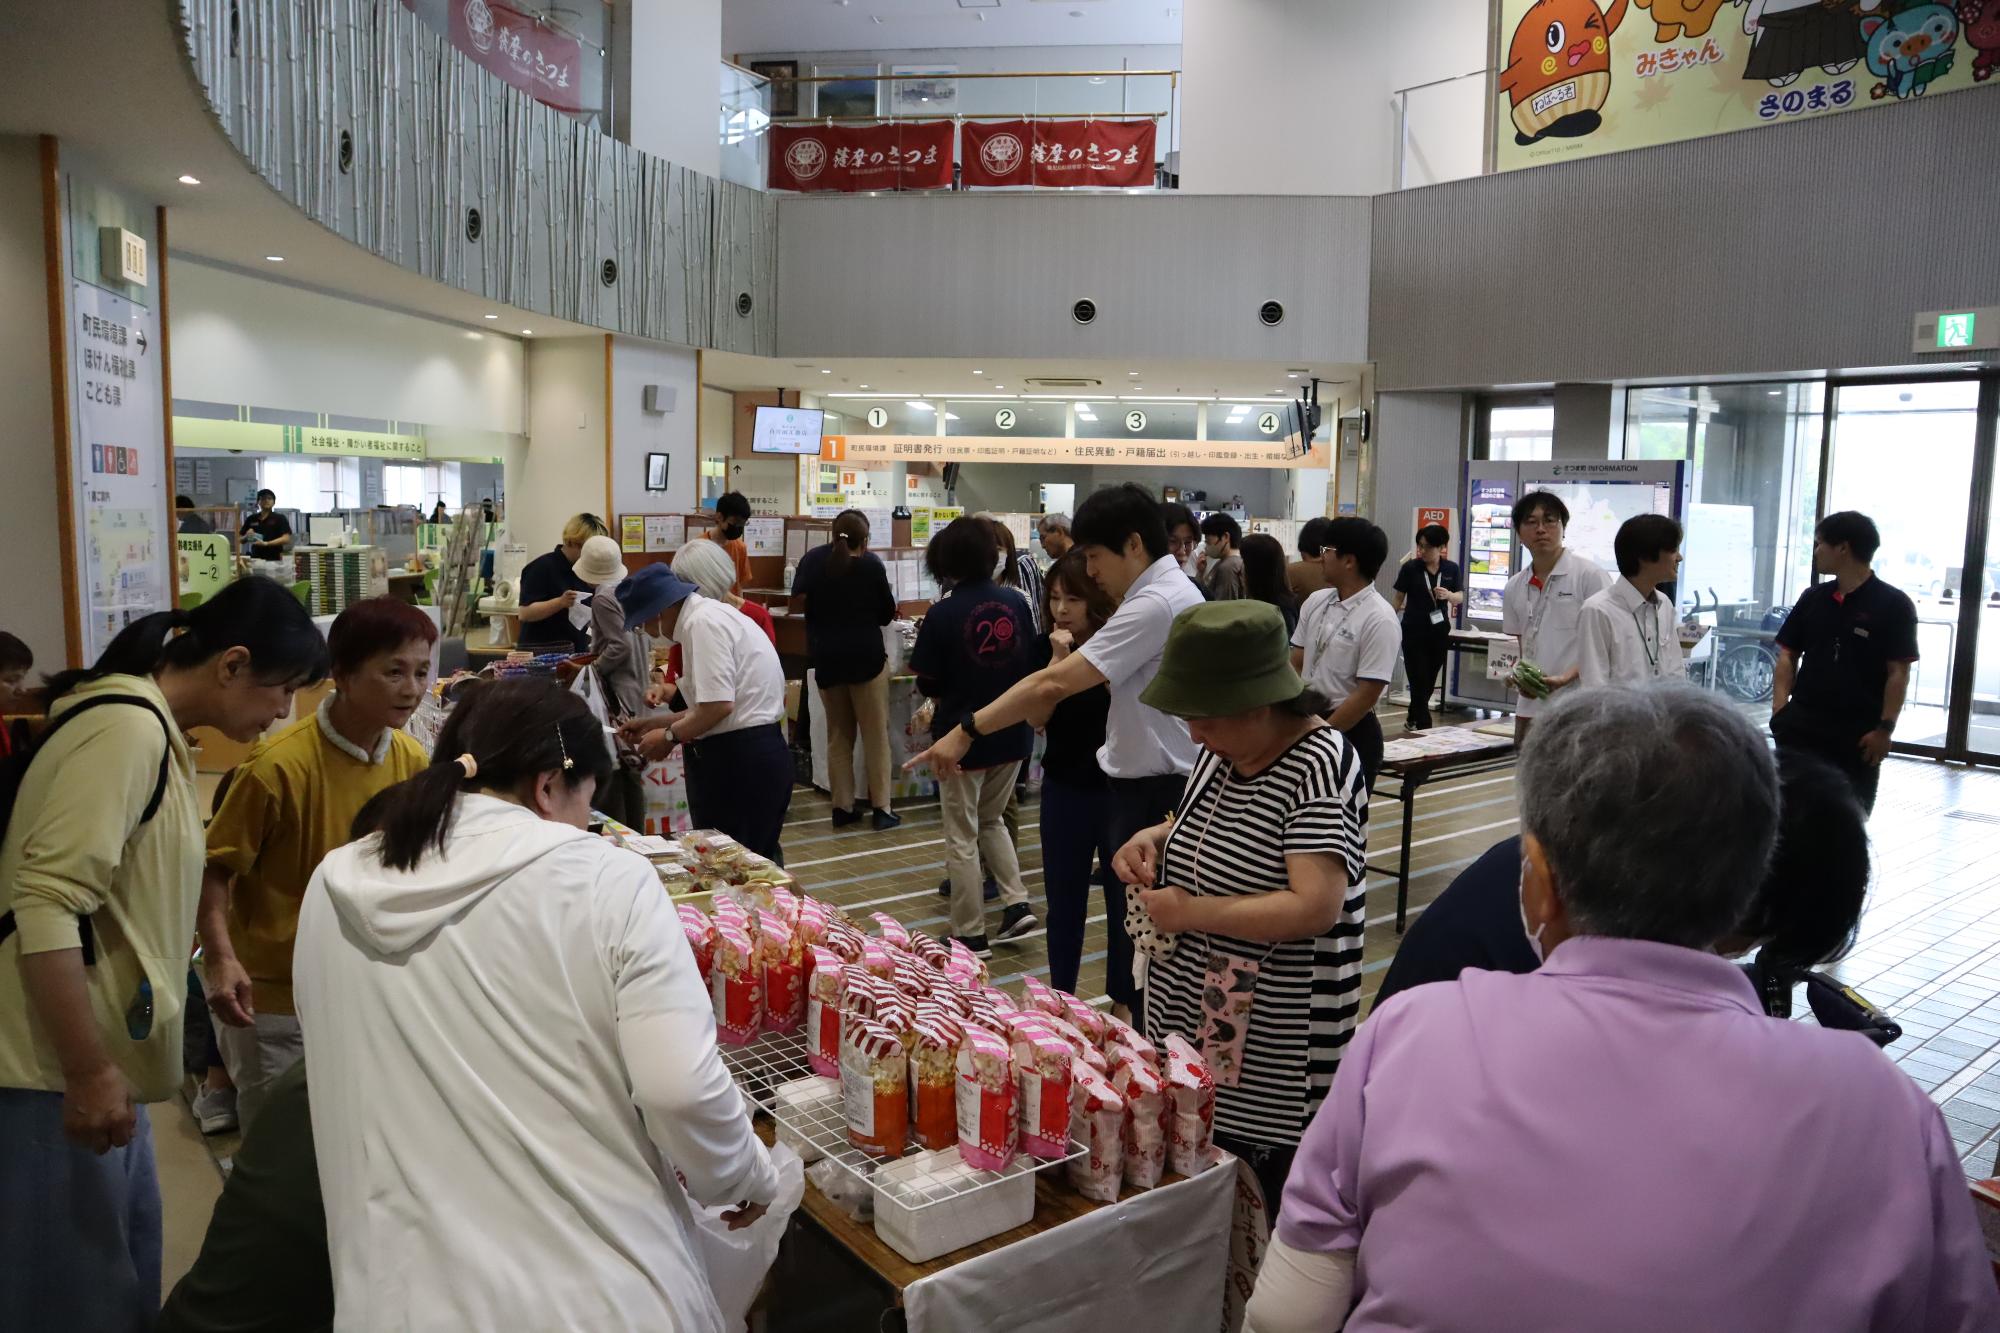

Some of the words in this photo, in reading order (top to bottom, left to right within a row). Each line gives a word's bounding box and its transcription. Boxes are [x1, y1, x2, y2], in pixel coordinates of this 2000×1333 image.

[1636, 39, 1721, 75] みきゃん
[1759, 80, 1853, 118] さのまる
[833, 145, 938, 168] 薩摩のさつま
[1031, 143, 1139, 165] 薩摩のさつま
[828, 440, 837, 459] 1
[1588, 465, 1639, 473] INFORMATION
[1424, 511, 1445, 521] AED
[204, 543, 217, 561] 4
